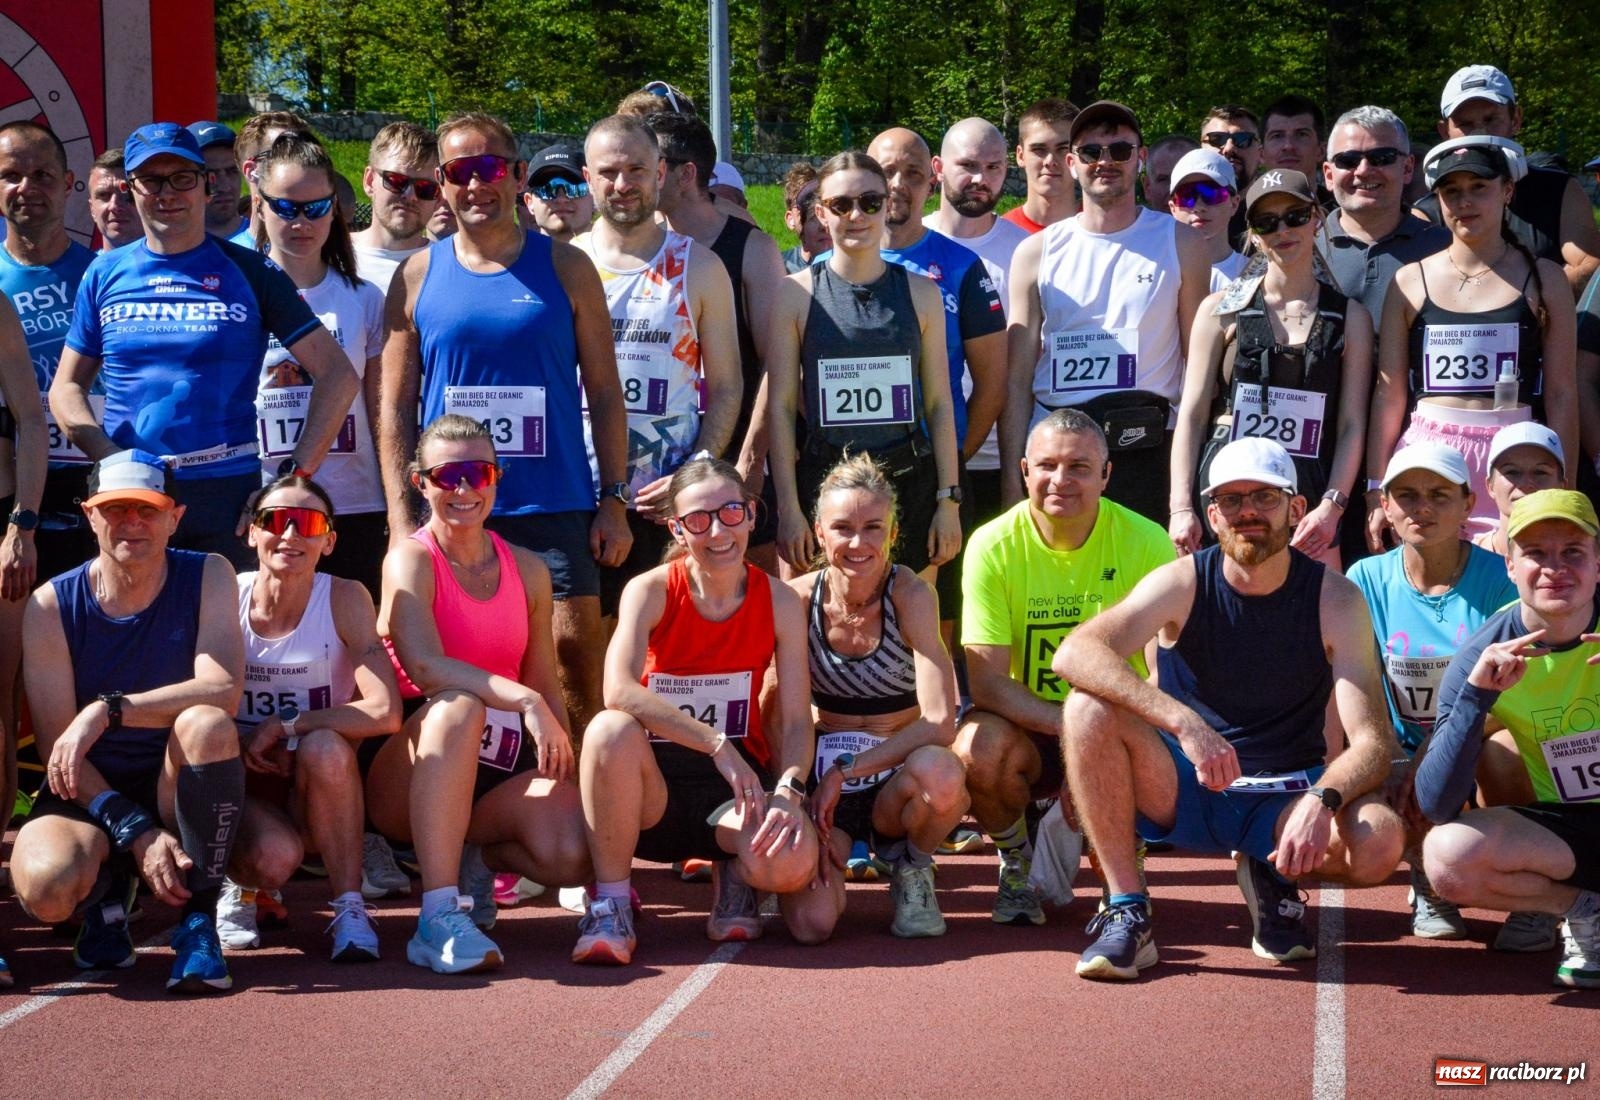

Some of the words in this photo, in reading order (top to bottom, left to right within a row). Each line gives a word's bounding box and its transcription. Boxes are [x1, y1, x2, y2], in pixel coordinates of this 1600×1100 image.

[100, 302, 248, 326] RUNNERS
[613, 329, 672, 344] OZIOŁKÓW
[1057, 342, 1088, 350] 3MAJA2026
[628, 354, 650, 362] GRANIC
[868, 362, 891, 370] GRANIC
[1064, 357, 1110, 382] 227
[1436, 355, 1488, 380] 233
[825, 372, 860, 380] 3MAJA2026
[836, 388, 882, 413] 210
[1242, 396, 1276, 406] 3MAJA26
[1287, 394, 1308, 402] GRANIC
[264, 401, 301, 410] 3MAJA2026
[276, 418, 304, 444] 17
[1243, 414, 1296, 442] 228
[1028, 597, 1054, 606] new
[1028, 609, 1048, 619] run
[1054, 607, 1080, 618] club
[250, 666, 265, 674] BIEG
[282, 667, 308, 675] GRANIC
[1392, 668, 1427, 677] 3MAJA2026
[243, 690, 298, 716] 135
[1405, 687, 1433, 710] 17
[1531, 694, 1600, 741] FO
[859, 737, 870, 745] BEZ
[1550, 742, 1568, 751] XVIII
[1570, 738, 1589, 748] BIEG
[1590, 736, 1600, 744] BE
[824, 743, 861, 752] 3MAJA2026
[1552, 745, 1597, 758] 3MAJA2026
[1572, 762, 1600, 790] 19
